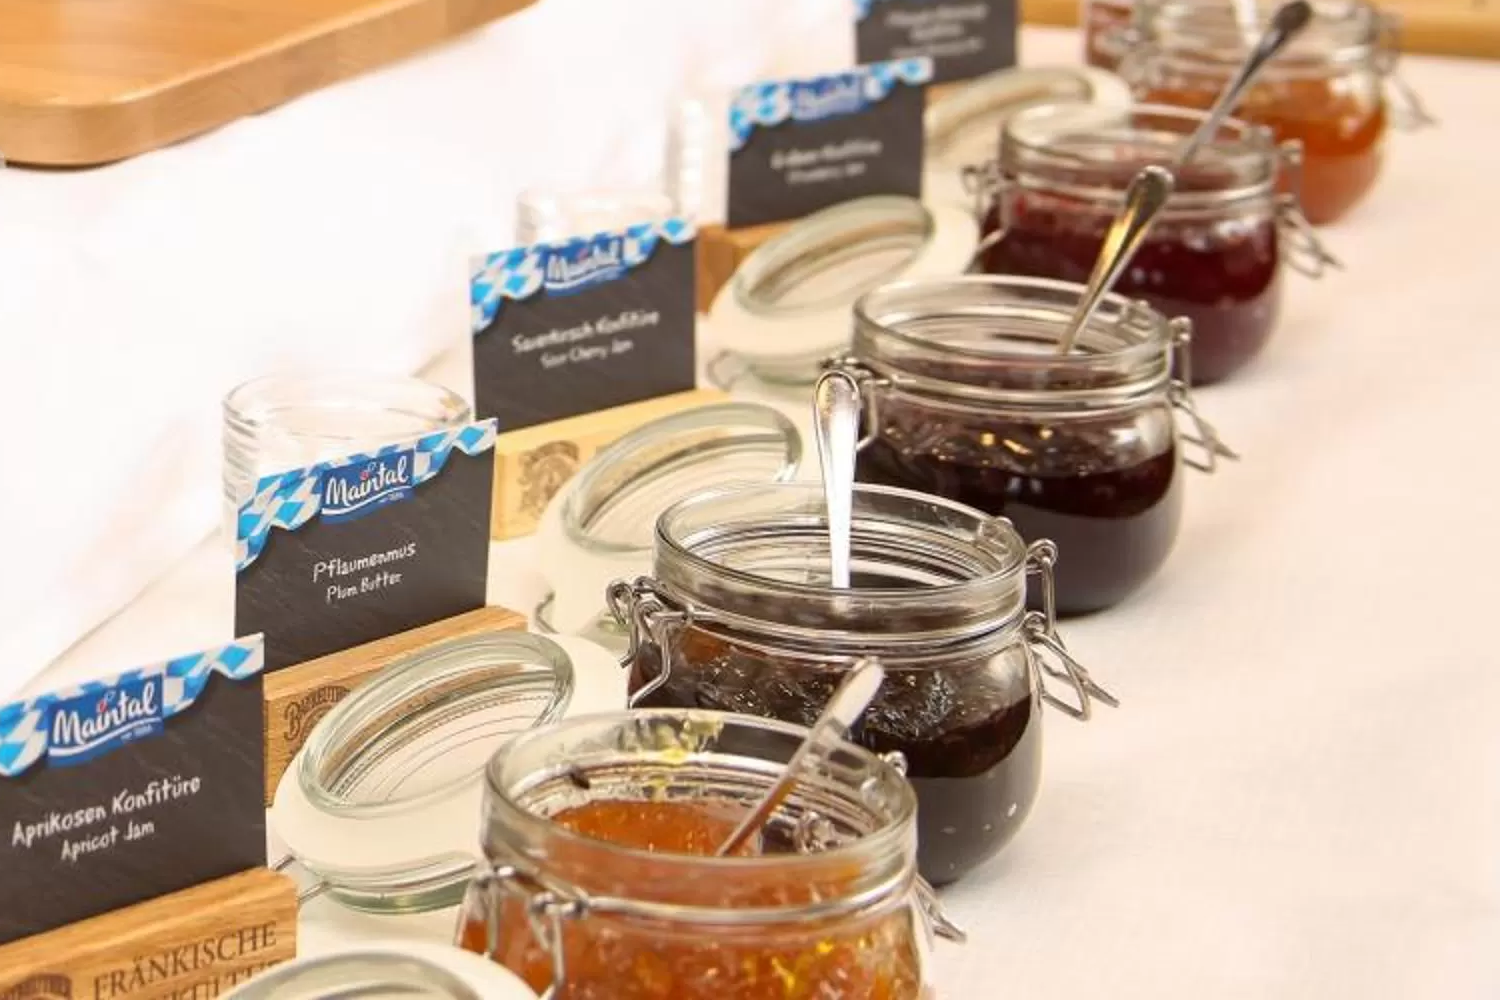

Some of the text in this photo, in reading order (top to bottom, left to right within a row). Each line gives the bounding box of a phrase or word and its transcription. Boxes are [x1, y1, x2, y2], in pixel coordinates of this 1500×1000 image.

[325, 455, 409, 507] Maintal
[312, 542, 417, 583] Pflaumenmus
[325, 570, 403, 605] Plum Butter
[52, 680, 159, 745] Maintal
[11, 774, 202, 848] Aprikosen Konfitüre
[60, 819, 156, 863] Apricot Jam
[93, 919, 278, 1000] FRÄNKISCHE
